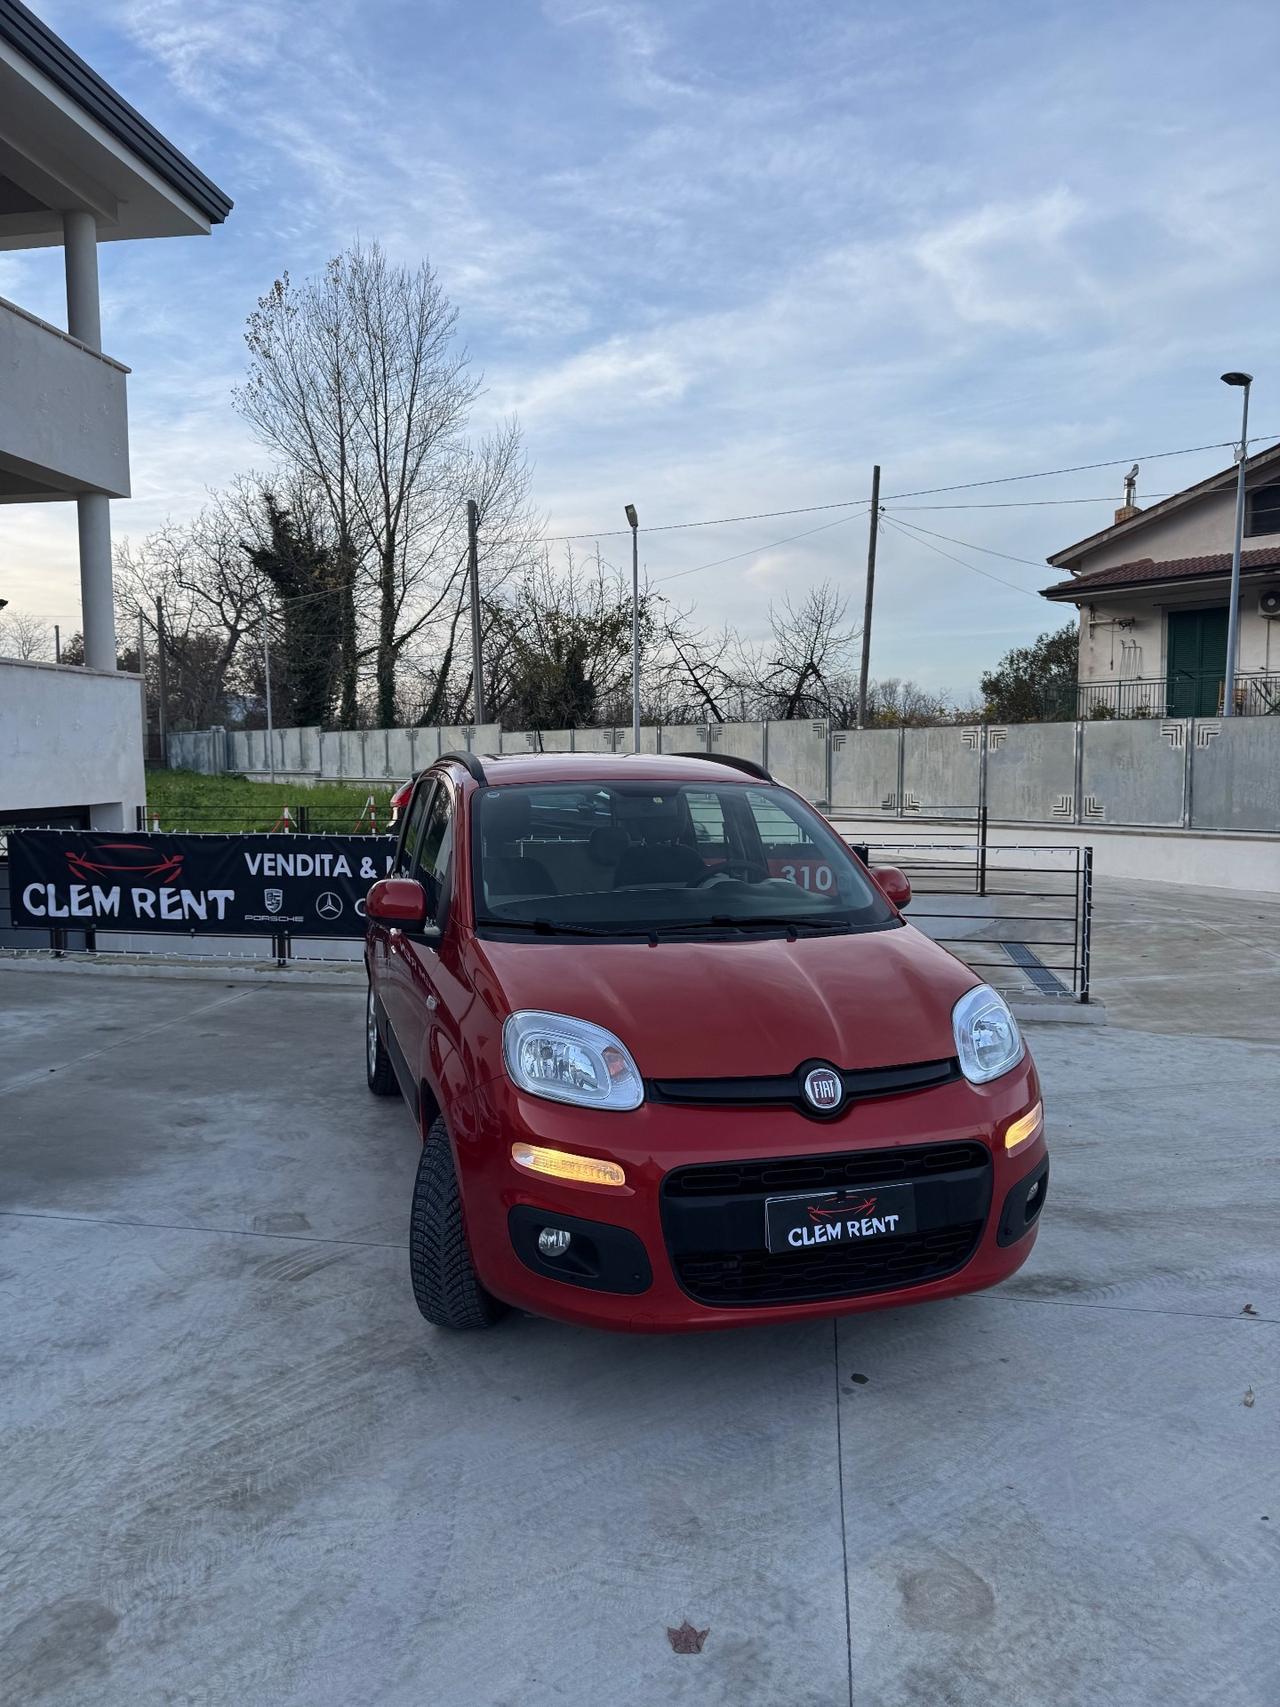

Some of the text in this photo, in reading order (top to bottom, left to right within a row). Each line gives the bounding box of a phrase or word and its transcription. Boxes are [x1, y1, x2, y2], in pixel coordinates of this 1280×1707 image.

[244, 852, 353, 878] VENDITA
[360, 856, 378, 879] &
[781, 865, 833, 891] 310
[22, 882, 236, 920] CLEM RENT
[244, 914, 304, 923] PORSCHE
[813, 1079, 835, 1099] FIAT
[787, 1214, 899, 1247] CLEM RENT
